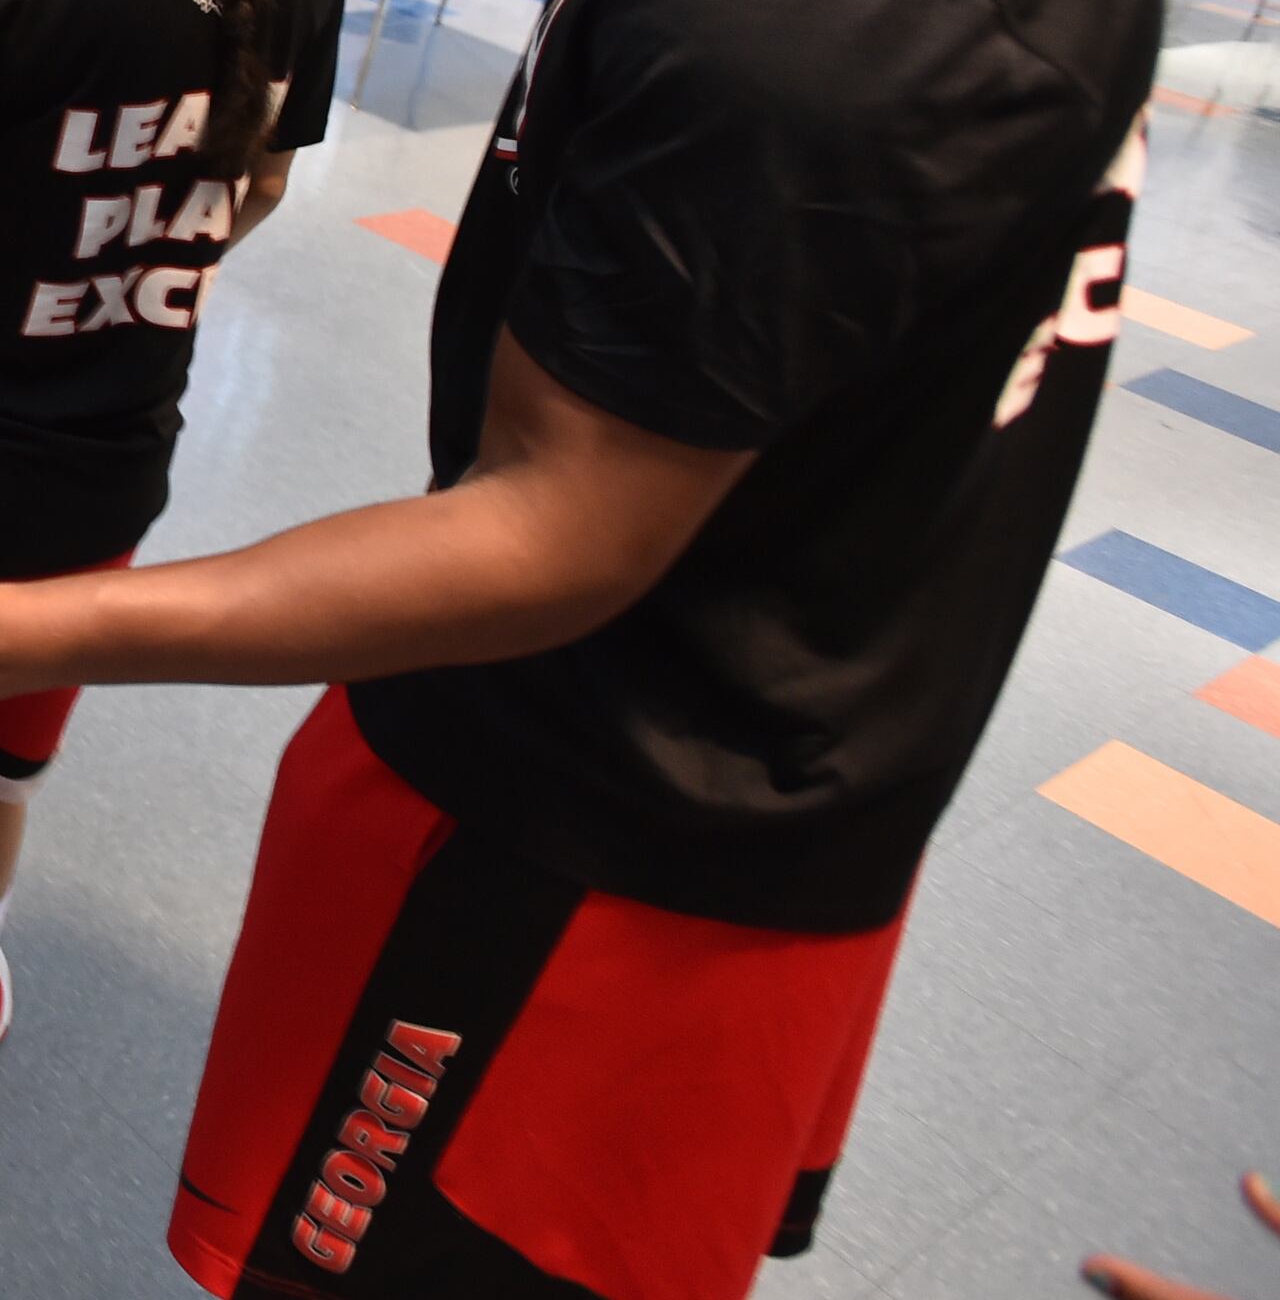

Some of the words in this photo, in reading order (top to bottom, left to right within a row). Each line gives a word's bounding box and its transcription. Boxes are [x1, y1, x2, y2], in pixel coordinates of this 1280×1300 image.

[52, 78, 290, 174] LEA
[22, 262, 222, 338] EXC
[292, 1018, 462, 1275] GEORGIA
